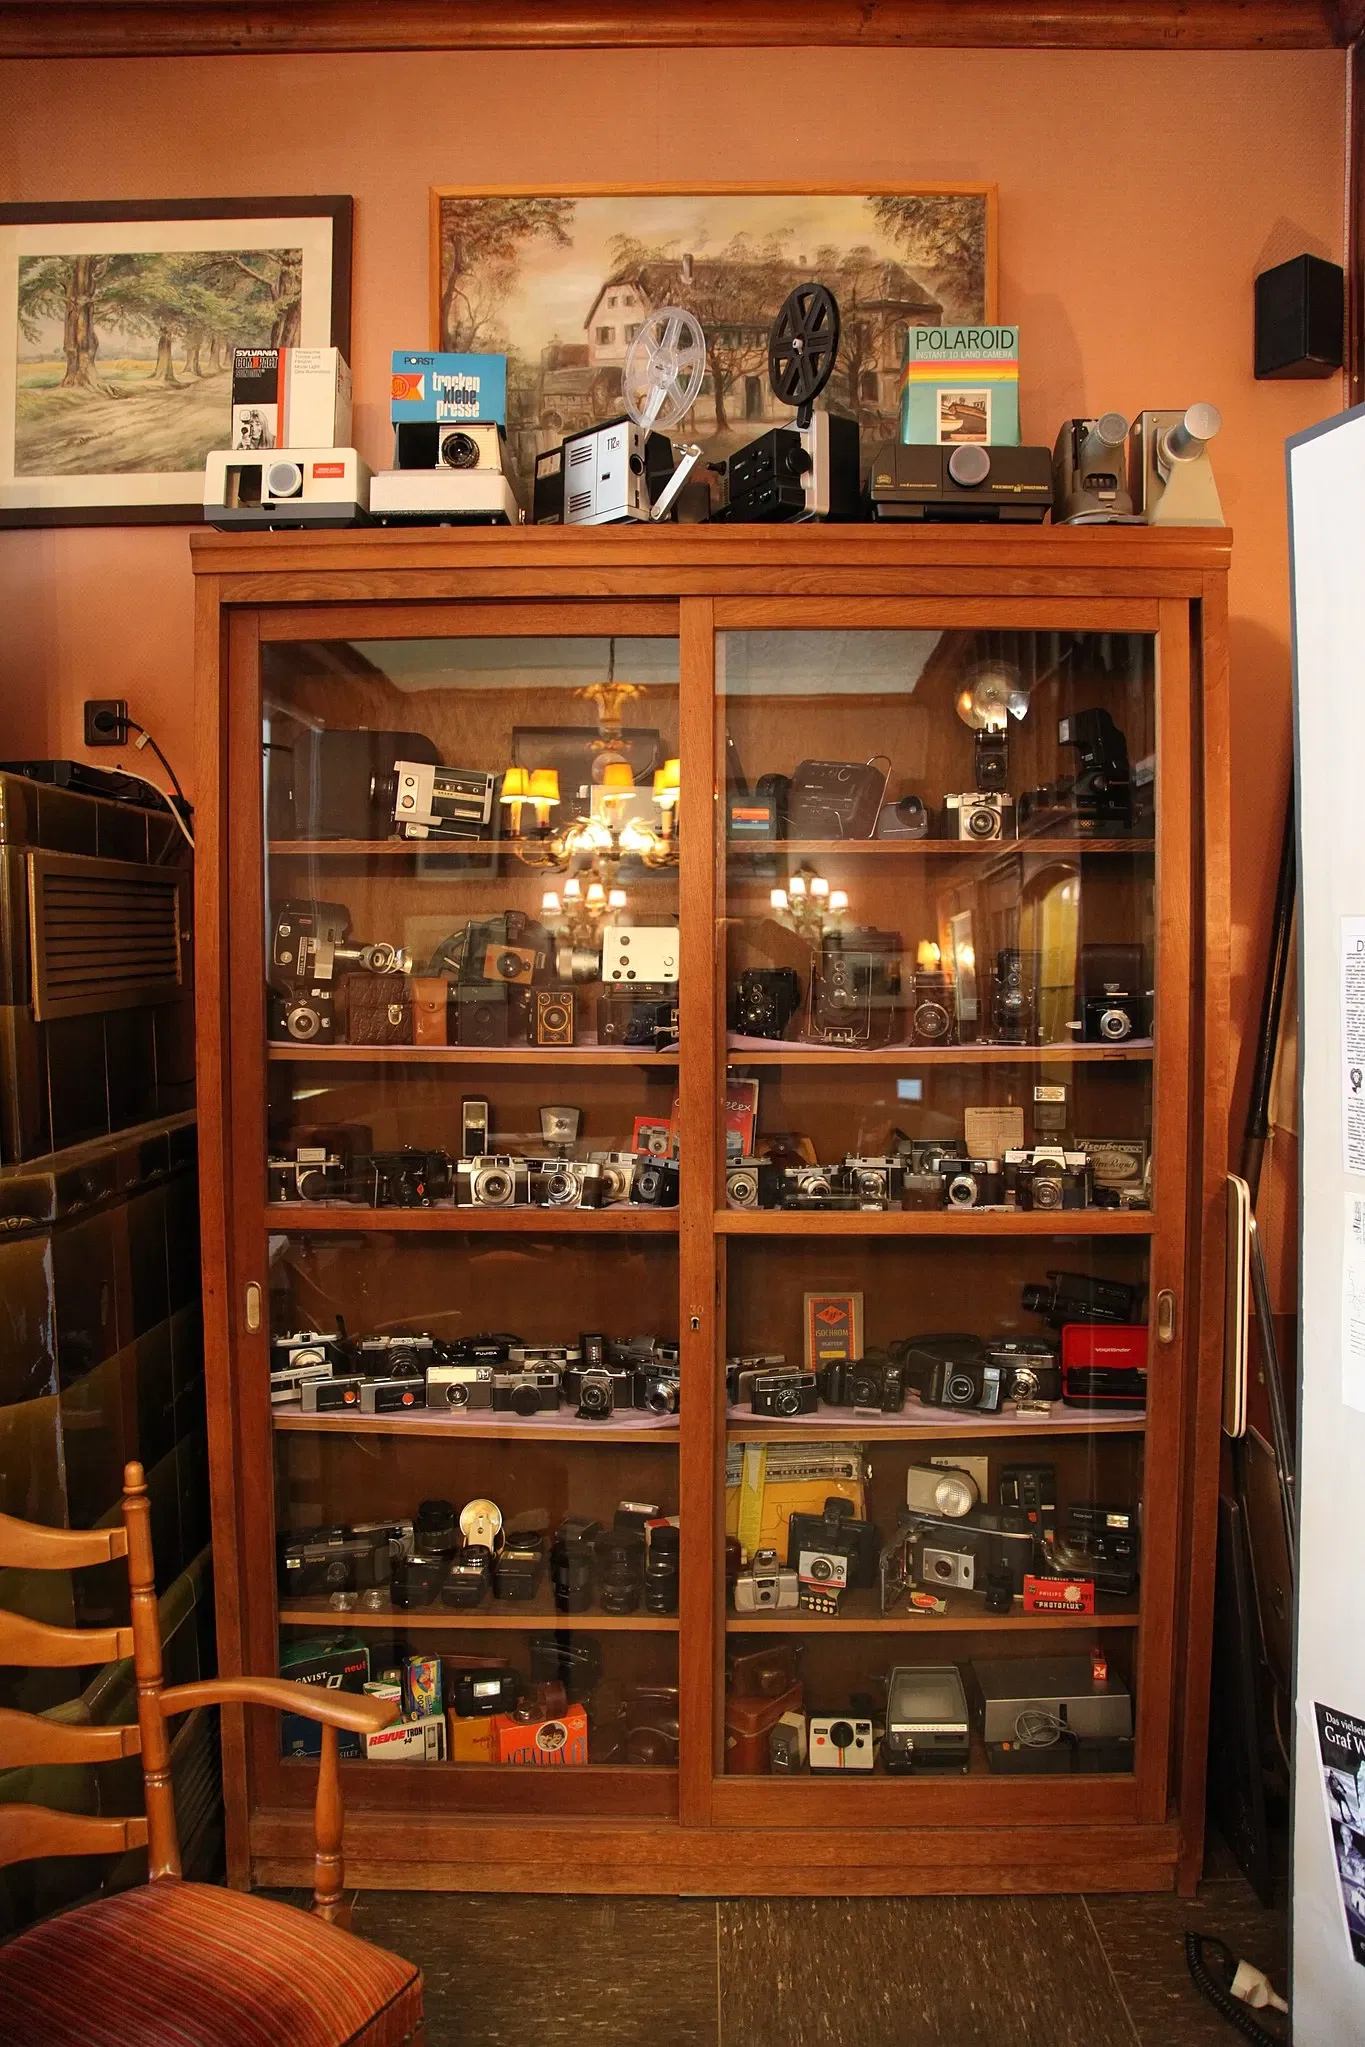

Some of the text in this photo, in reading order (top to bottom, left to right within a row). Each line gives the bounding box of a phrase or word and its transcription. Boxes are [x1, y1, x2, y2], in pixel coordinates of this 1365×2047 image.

[916, 330, 1014, 350] POLAROID
[236, 349, 278, 357] SYLVANIA
[404, 356, 436, 365] PORST
[915, 351, 947, 360] INSTANT
[982, 350, 1013, 358] CAMERA
[432, 371, 481, 393] trocken
[443, 385, 477, 405] klebe
[436, 399, 480, 420] presse
[815, 1329, 849, 1337] ISOCHROM
[1325, 1711, 1340, 1726] Das
[369, 1726, 423, 1746] REVUE TRON
[1324, 1725, 1353, 1750] Graf
